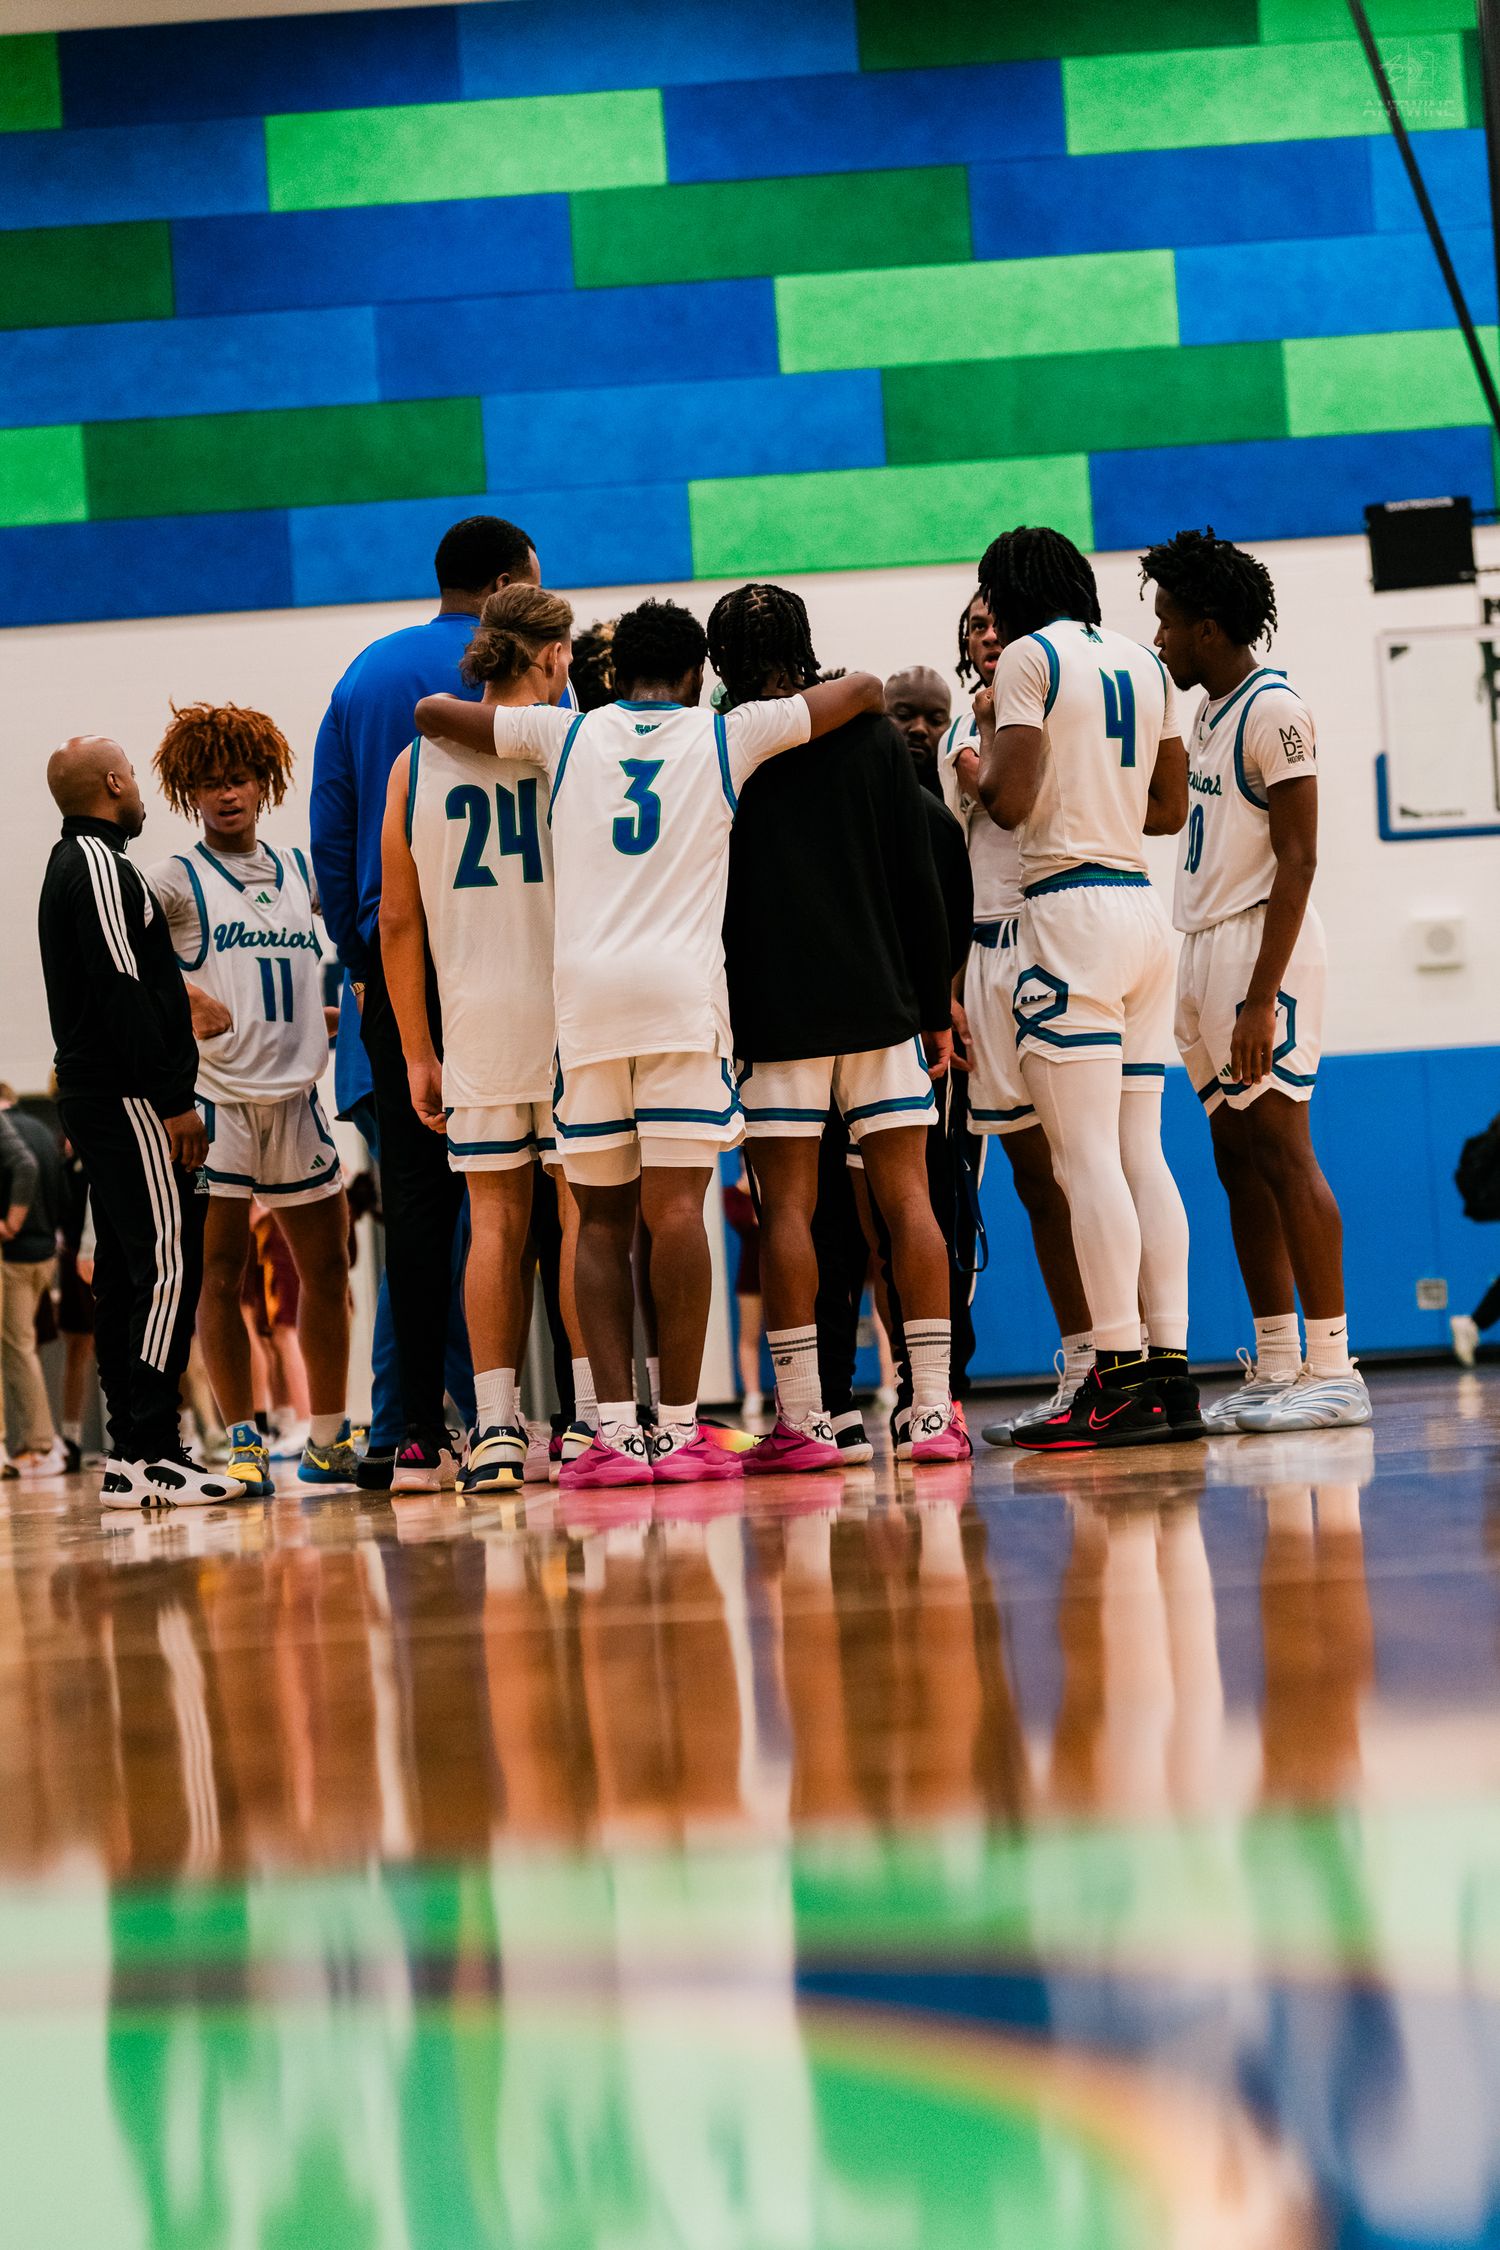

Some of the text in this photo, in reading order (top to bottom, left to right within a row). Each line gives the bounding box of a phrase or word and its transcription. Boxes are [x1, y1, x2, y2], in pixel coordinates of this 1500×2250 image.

[1099, 668, 1136, 768] 4
[445, 778, 544, 889] 24
[612, 758, 665, 856] 3
[213, 921, 318, 952] Warriors
[255, 957, 294, 1023] 11
